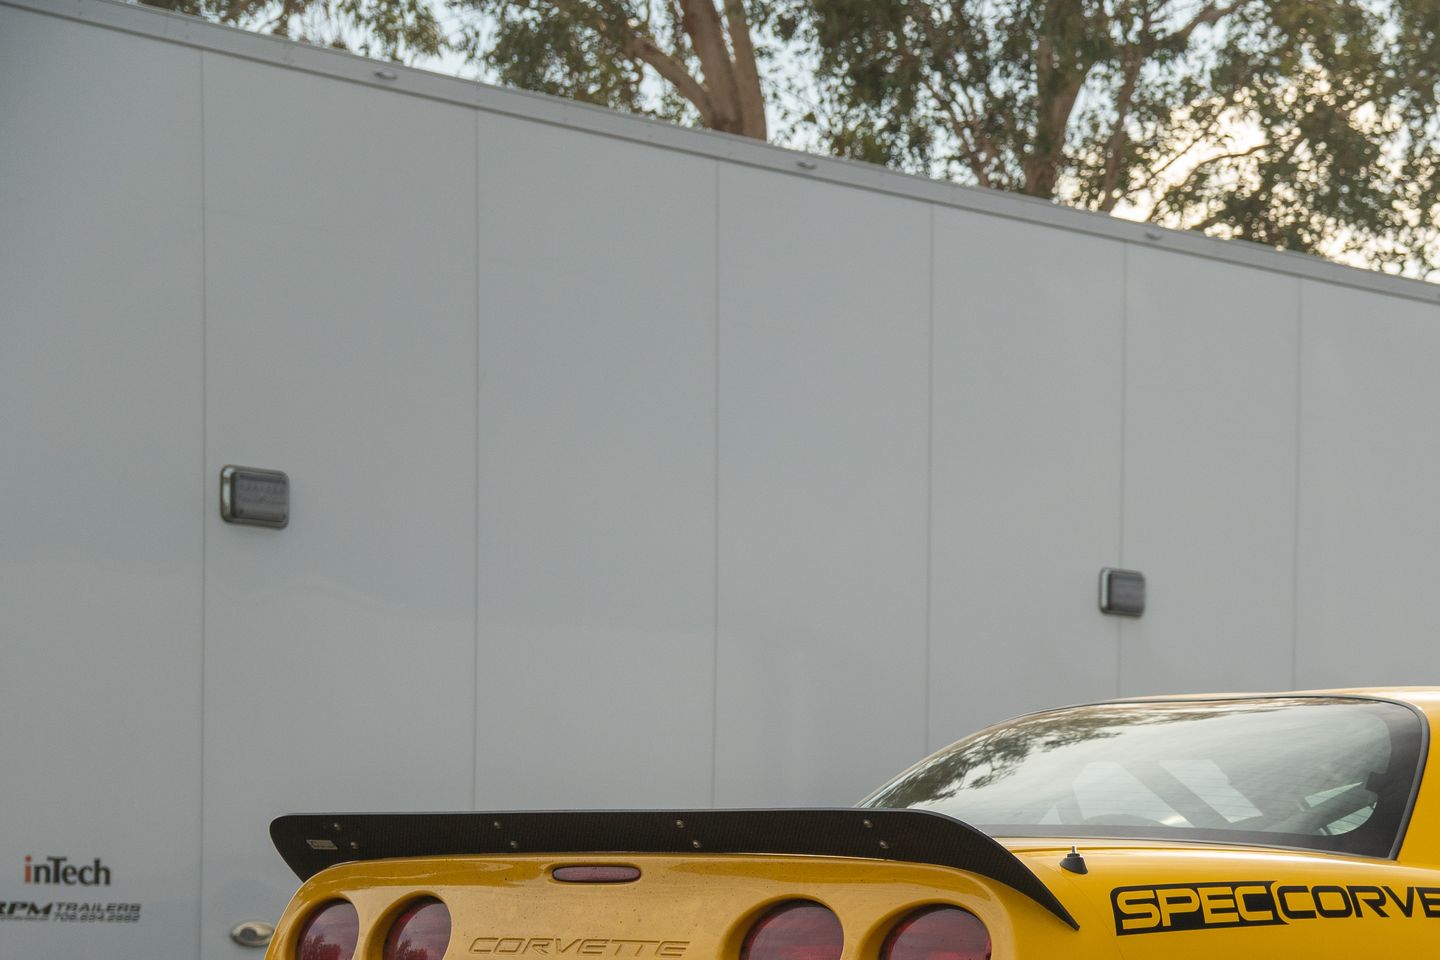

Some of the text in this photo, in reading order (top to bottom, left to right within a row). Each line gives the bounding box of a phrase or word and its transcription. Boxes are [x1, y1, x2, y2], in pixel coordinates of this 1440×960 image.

[24, 855, 111, 886] inTech
[56, 902, 141, 912] TRAILERS
[468, 937, 691, 958] CORVETTE
